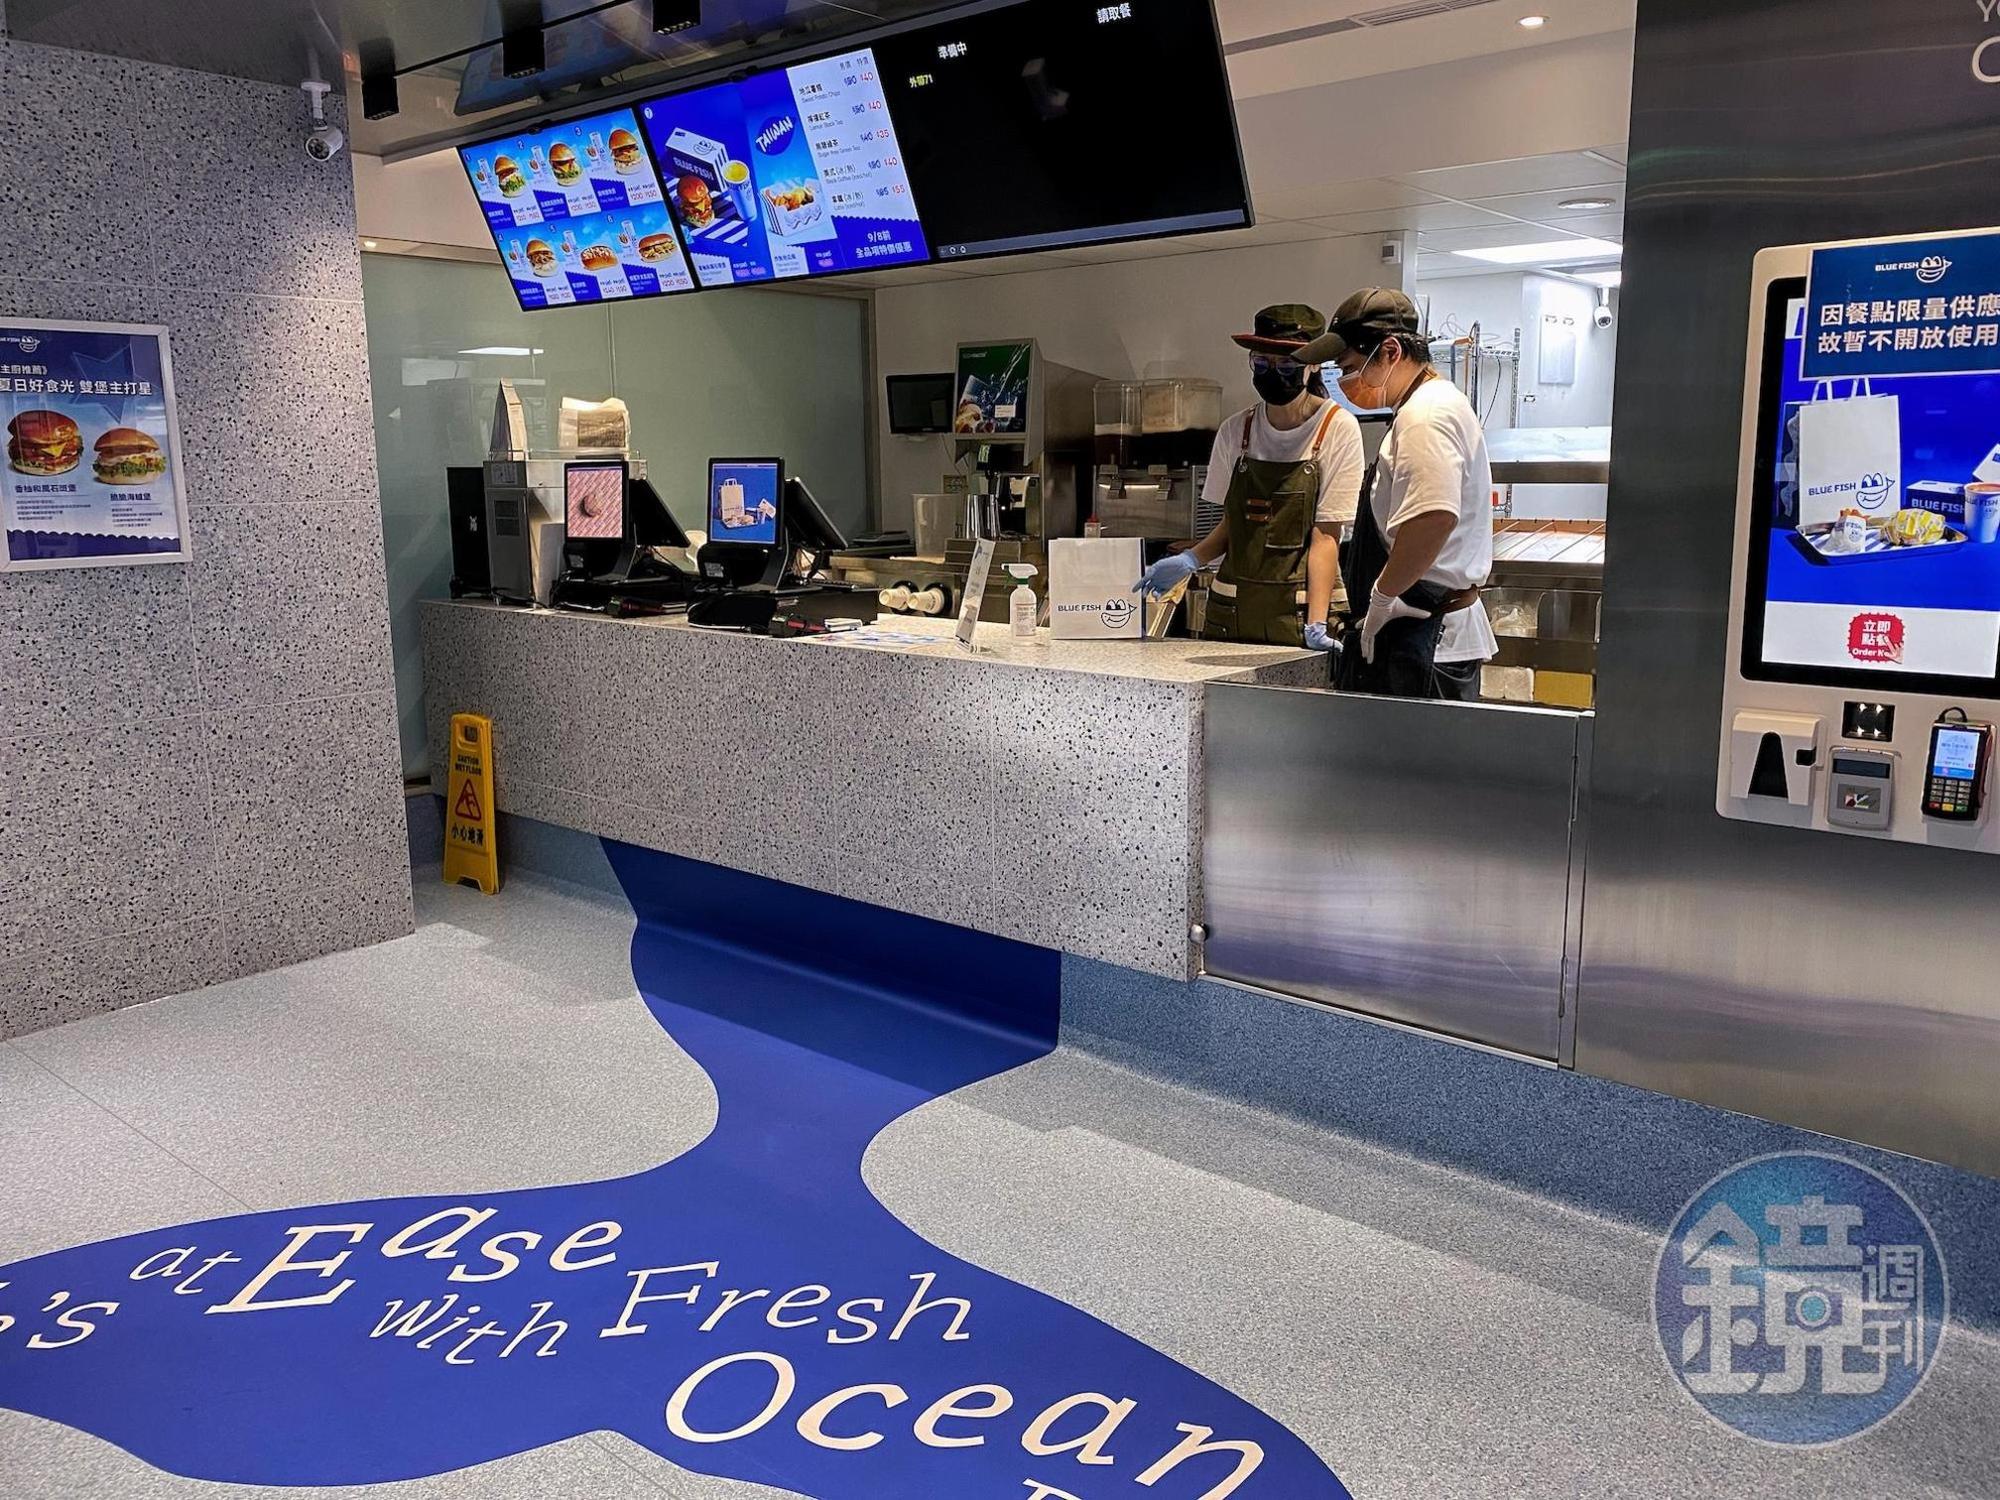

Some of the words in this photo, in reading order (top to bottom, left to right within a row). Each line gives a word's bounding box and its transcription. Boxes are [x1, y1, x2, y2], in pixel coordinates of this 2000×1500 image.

[1096, 3, 1132, 24] 請取餐
[938, 41, 967, 59] 準備中
[756, 115, 794, 153] TAIWAN
[867, 230, 891, 242] 9/8前
[1875, 263, 1898, 272] BLUE
[1899, 261, 1919, 270] FISH
[1820, 293, 2000, 327] 因餐點限量供應
[1817, 324, 1999, 354] 故暫不開放使用
[0, 377, 75, 394] 夏日好食光
[80, 380, 152, 395] 雙堡主打星
[1808, 485, 1833, 497] BLUE
[1834, 482, 1857, 493] FISH
[1911, 498, 1940, 510] BLUE
[1862, 620, 1891, 633] 立即
[1852, 648, 1877, 656] Order
[130, 1245, 242, 1294] at
[204, 1205, 623, 1314] Ease
[599, 1260, 972, 1344] Fresh
[665, 1351, 1265, 1500] Ocean
